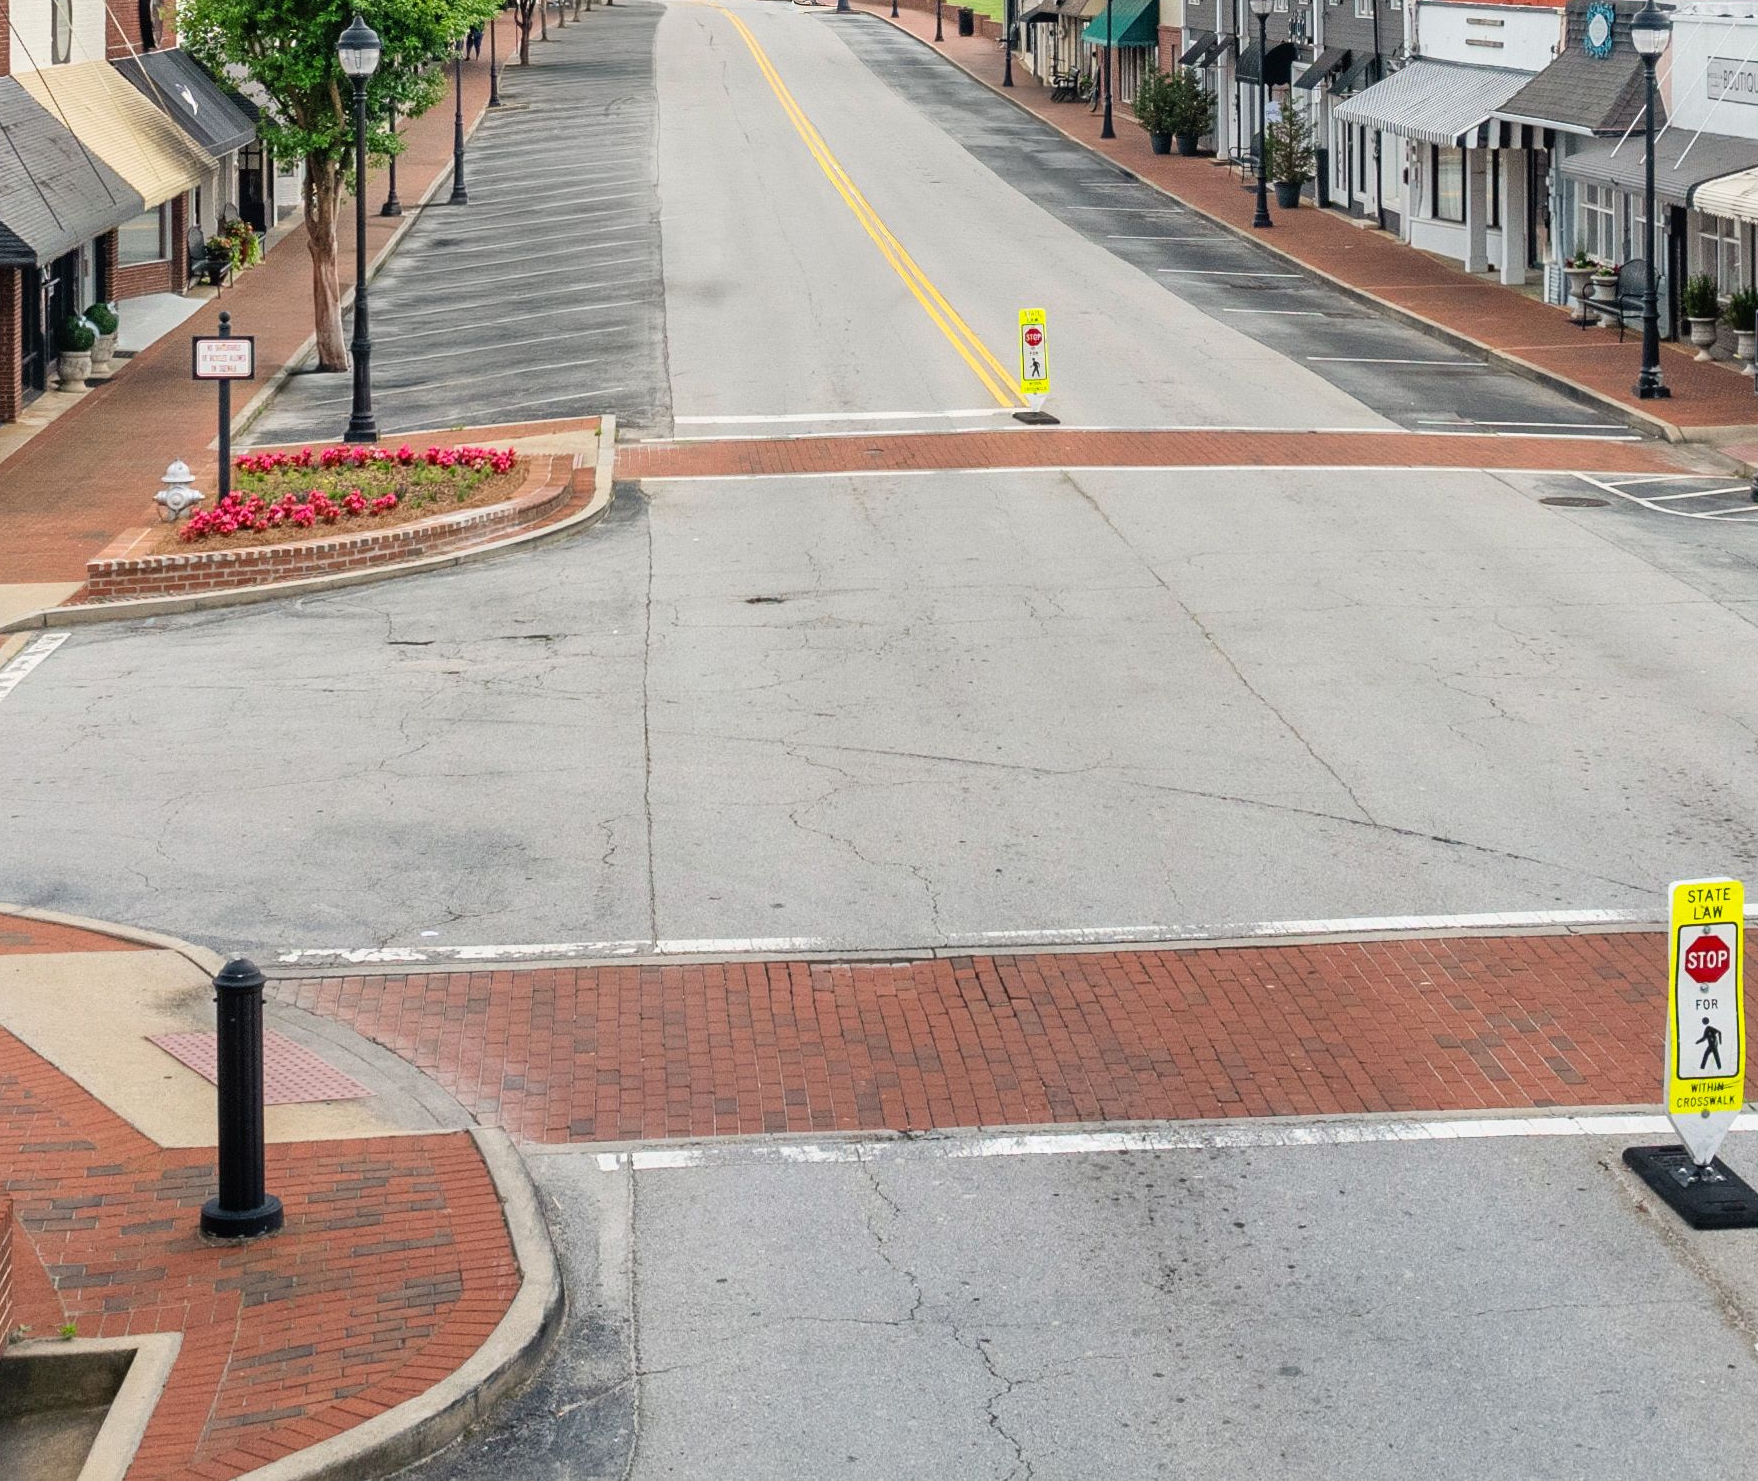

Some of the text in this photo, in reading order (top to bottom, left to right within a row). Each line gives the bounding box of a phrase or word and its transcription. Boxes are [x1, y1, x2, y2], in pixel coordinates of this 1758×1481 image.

[1026, 333, 1042, 342] STOP
[1687, 887, 1731, 903] STATE
[1694, 906, 1723, 920] LAW
[1687, 950, 1728, 969] STOP
[1695, 999, 1719, 1010] FOR
[1691, 1082, 1725, 1094] WITHIN
[1676, 1095, 1736, 1109] CROSSWALK
